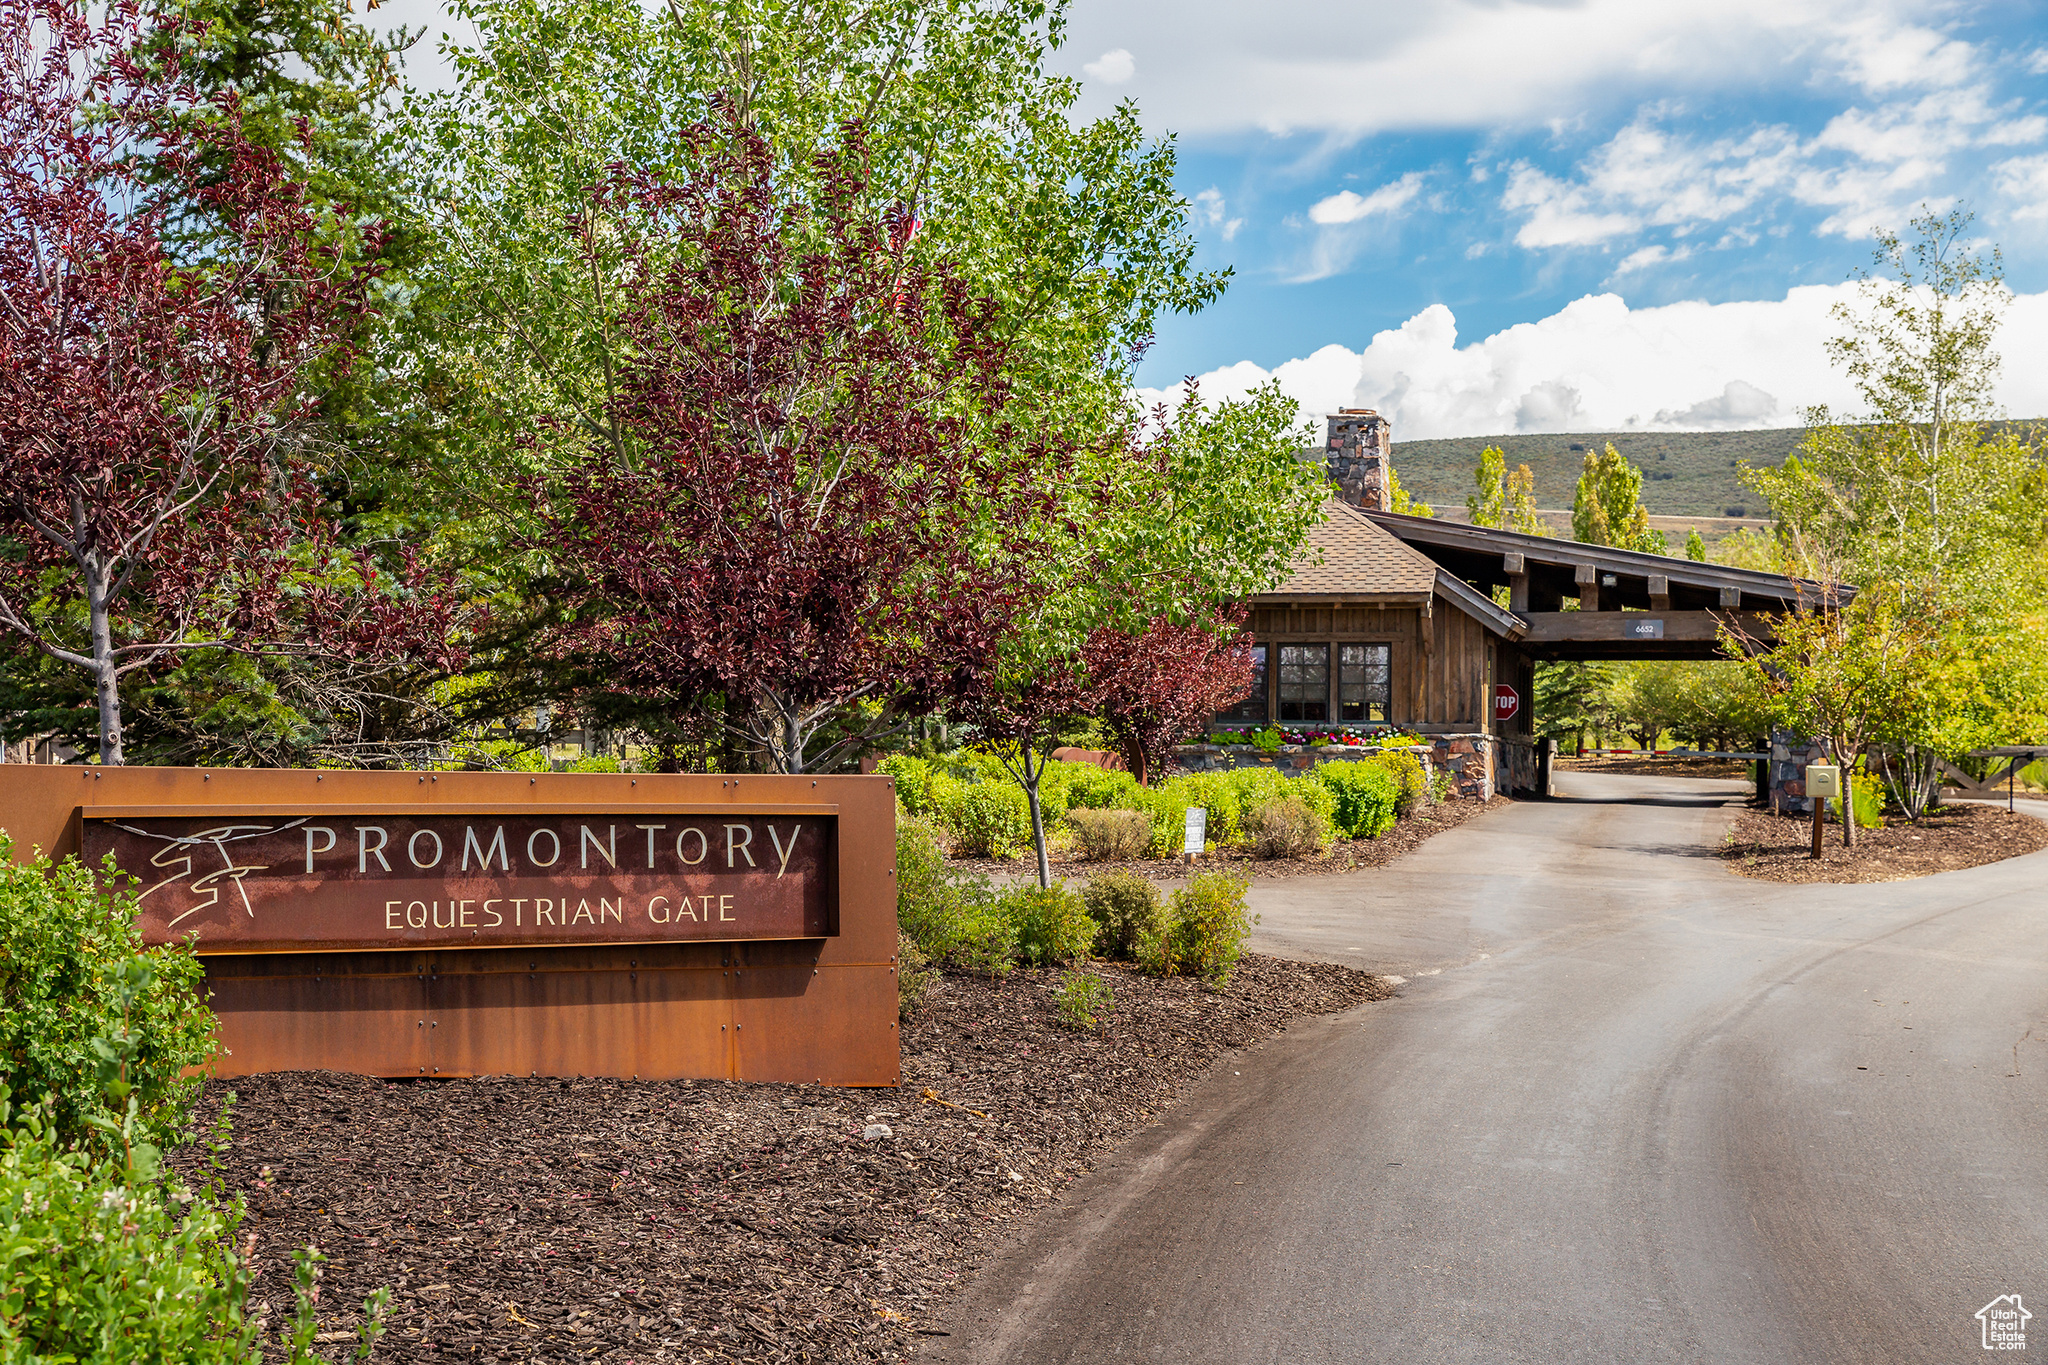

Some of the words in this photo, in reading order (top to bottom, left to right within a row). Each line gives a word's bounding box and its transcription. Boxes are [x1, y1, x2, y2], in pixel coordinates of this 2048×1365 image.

[1635, 625, 1654, 633] 6652
[1495, 696, 1516, 709] TOP
[301, 824, 802, 879] PROMONTORY
[386, 897, 622, 930] EQUESTRIAN
[648, 895, 737, 924] GATE
